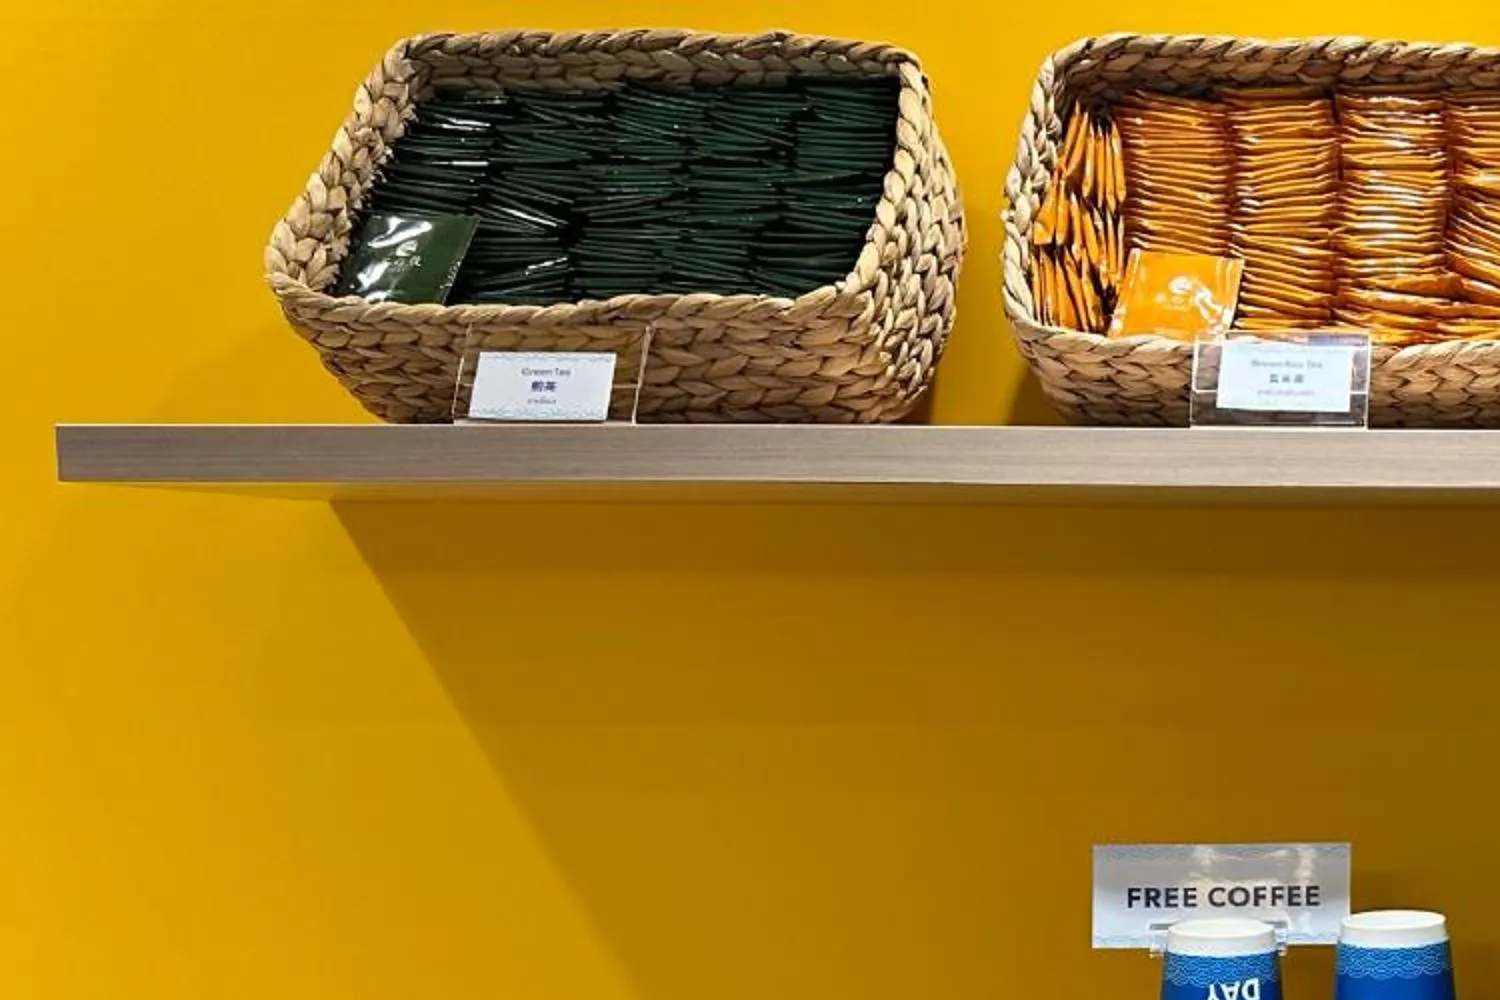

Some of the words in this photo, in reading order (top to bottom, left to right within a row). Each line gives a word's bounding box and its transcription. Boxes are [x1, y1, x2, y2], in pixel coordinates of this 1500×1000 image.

[520, 367, 553, 377] Green
[555, 367, 572, 377] Tea
[1127, 887, 1199, 909] FREE
[1207, 885, 1321, 908] COFFEE
